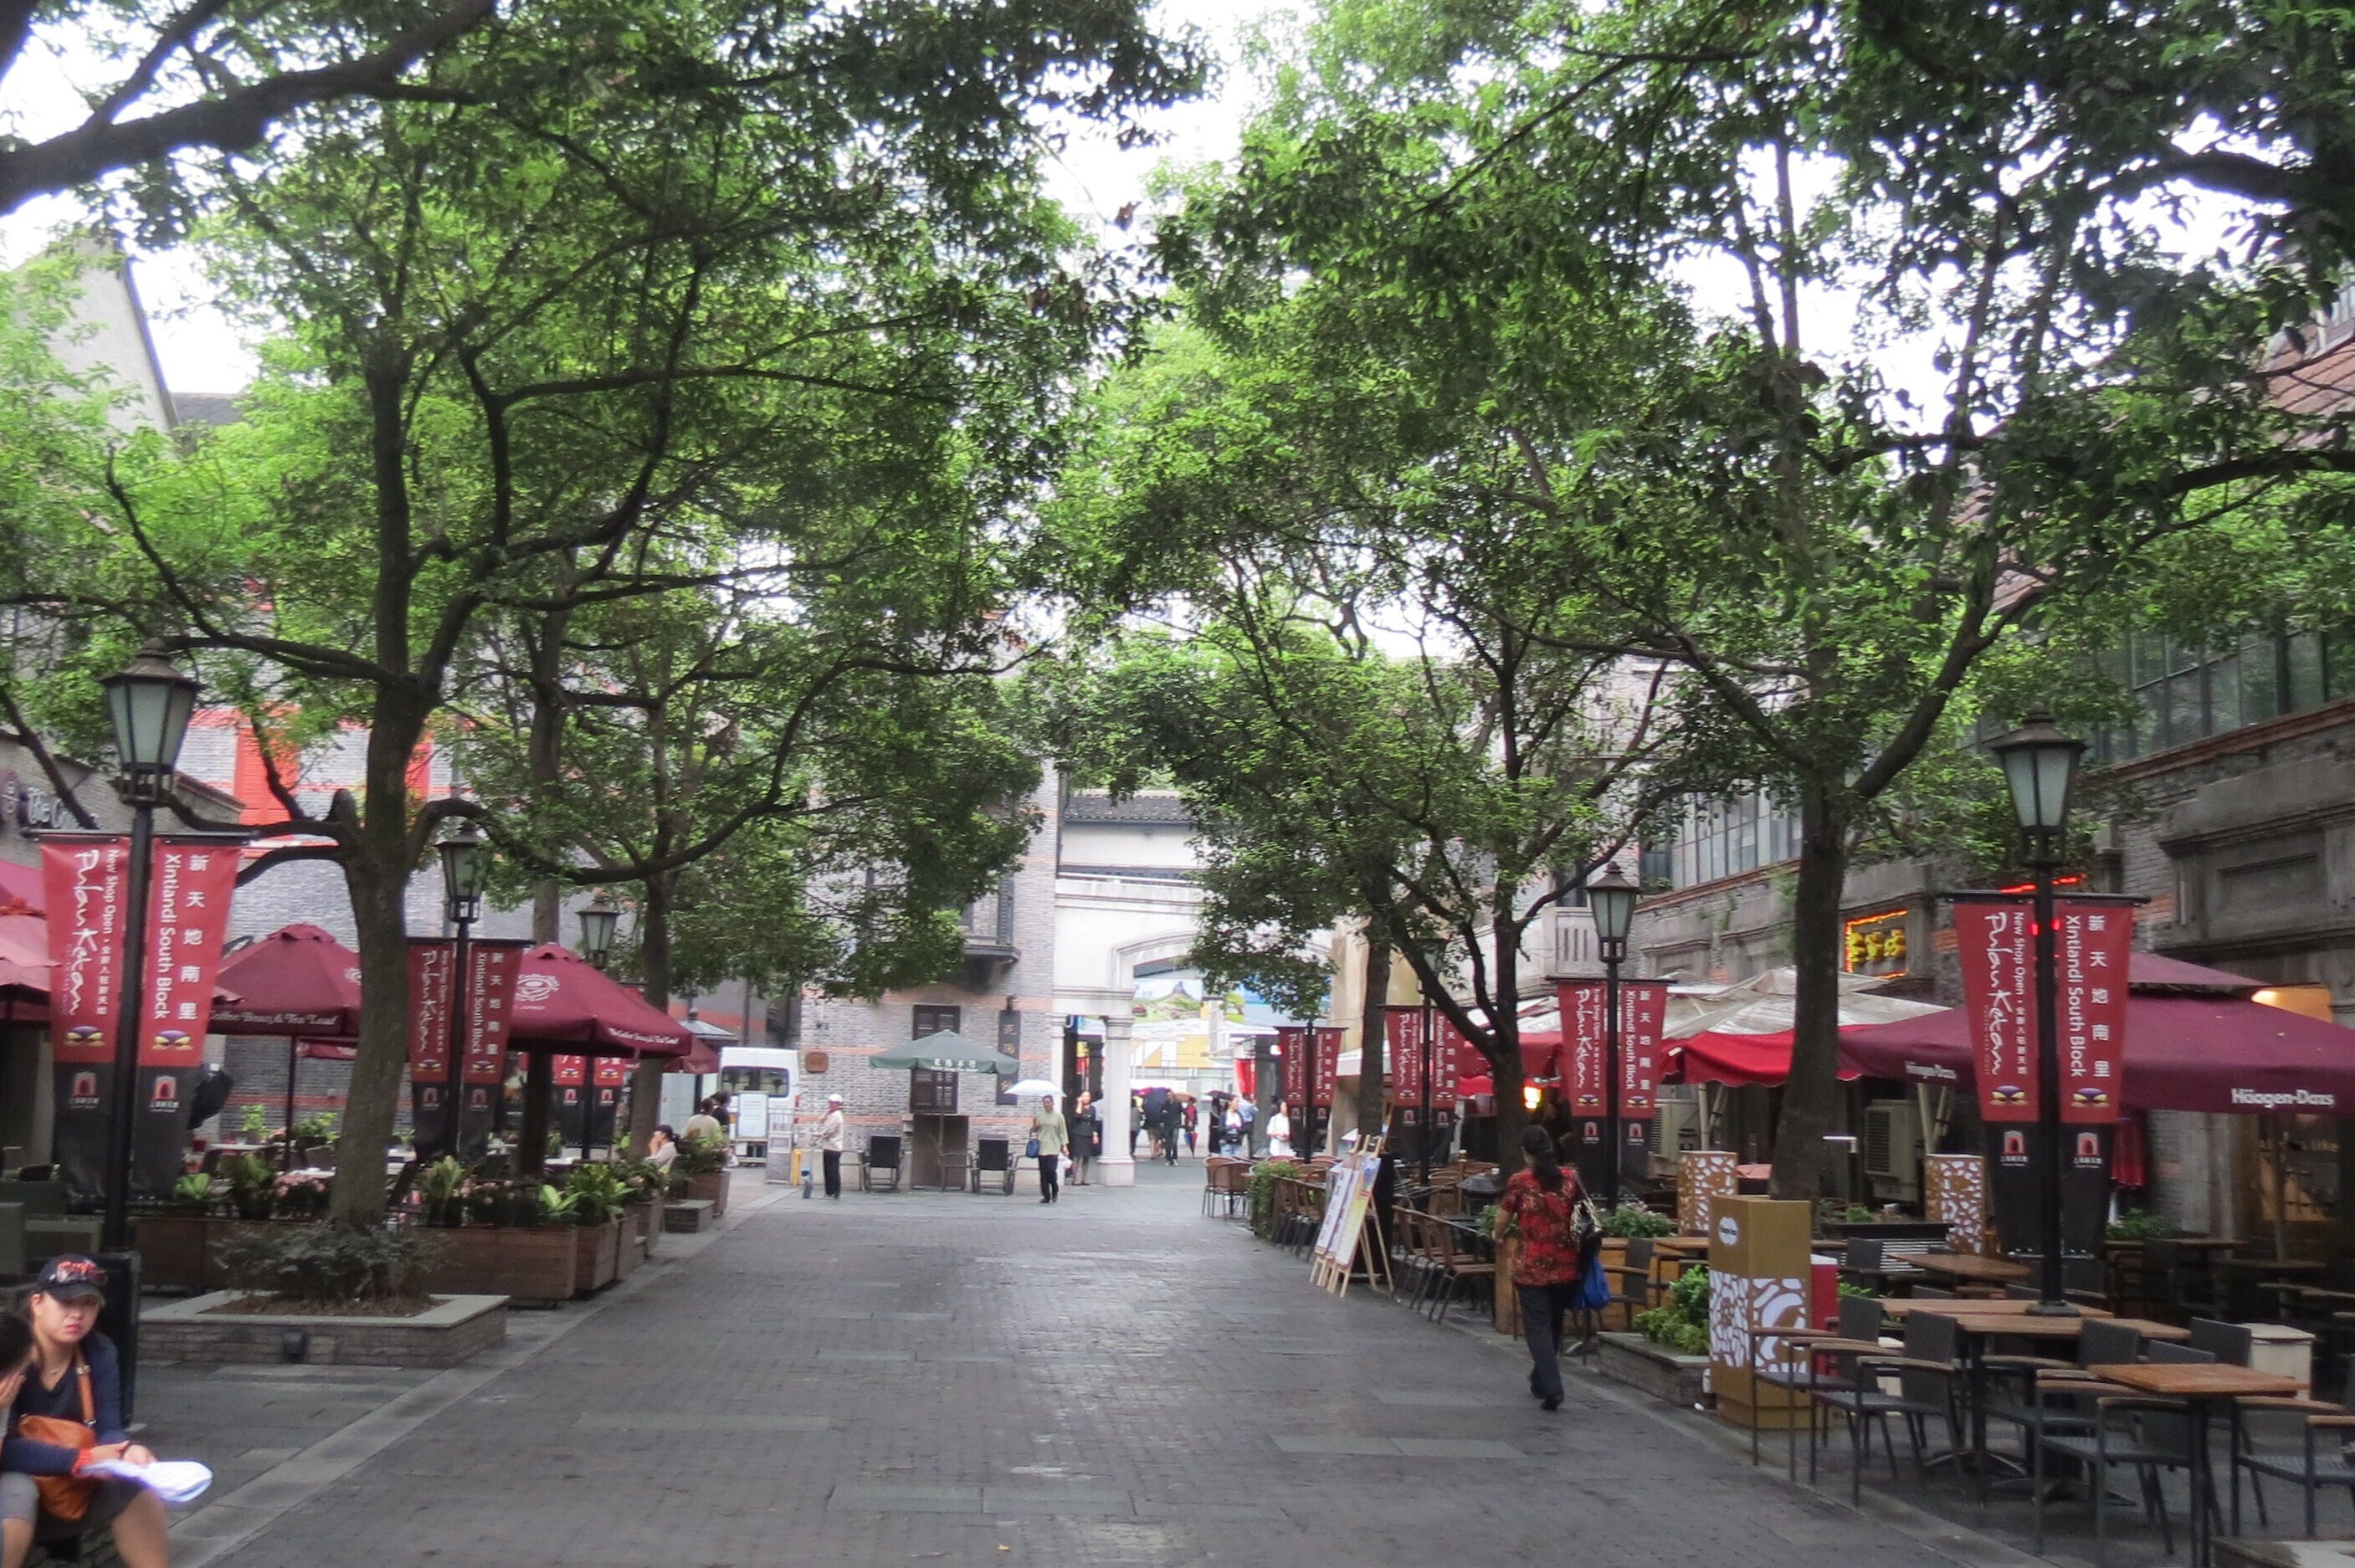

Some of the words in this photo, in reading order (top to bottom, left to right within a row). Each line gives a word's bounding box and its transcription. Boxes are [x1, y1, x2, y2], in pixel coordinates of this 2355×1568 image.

[107, 849, 120, 873] New
[103, 876, 119, 903] Shop
[160, 854, 182, 924] Xintiandi
[102, 905, 116, 934] Open
[177, 855, 209, 1020] 新天地南里
[2014, 912, 2025, 935] New
[157, 927, 176, 973] South
[2013, 938, 2025, 965] Shop
[2065, 915, 2083, 982] Xintiandi
[475, 952, 487, 995] Xintiandi
[2013, 966, 2027, 995] Open
[154, 977, 173, 1020] Block
[473, 999, 485, 1026] South
[486, 952, 504, 1055] 新天地南里
[1626, 990, 1636, 1033] Xintiandi
[2067, 986, 2085, 1032] South
[2088, 915, 2110, 1077] 新天地南里
[472, 1028, 483, 1054] Block
[1446, 1020, 1455, 1088] 天地南里
[1626, 1034, 1636, 1062] South
[1639, 990, 1652, 1090] 新天地南里
[2070, 1035, 2087, 1077] Block
[1626, 1064, 1636, 1089] Block
[2231, 1088, 2335, 1108] Häagen-Dazs
